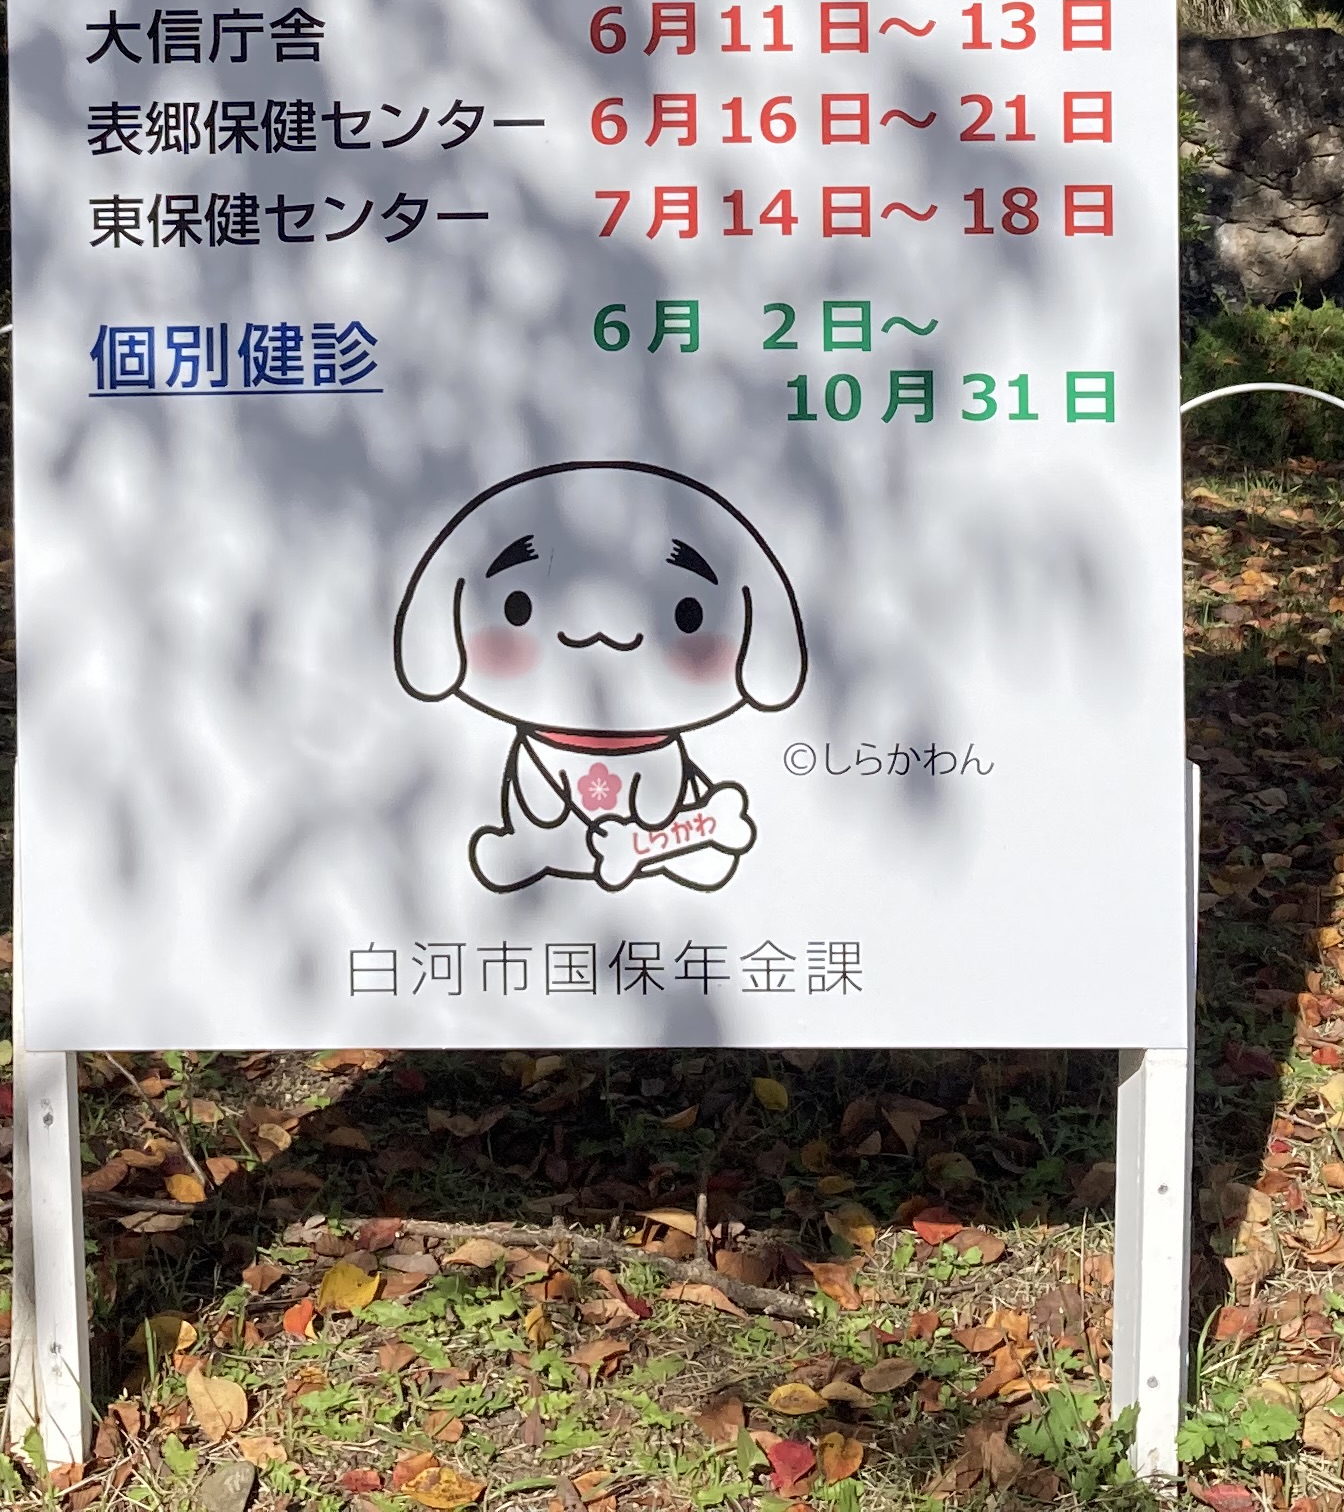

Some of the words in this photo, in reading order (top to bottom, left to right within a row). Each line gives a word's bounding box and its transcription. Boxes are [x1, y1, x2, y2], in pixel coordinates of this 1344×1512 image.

[86, 7, 326, 64] 大信庁舎
[88, 99, 545, 156] 表郷保健センター
[89, 192, 489, 248] 東保健センター
[90, 322, 379, 390] 個別健診
[632, 813, 717, 855] しらかわ
[350, 940, 862, 996] 白河市国保年金課
